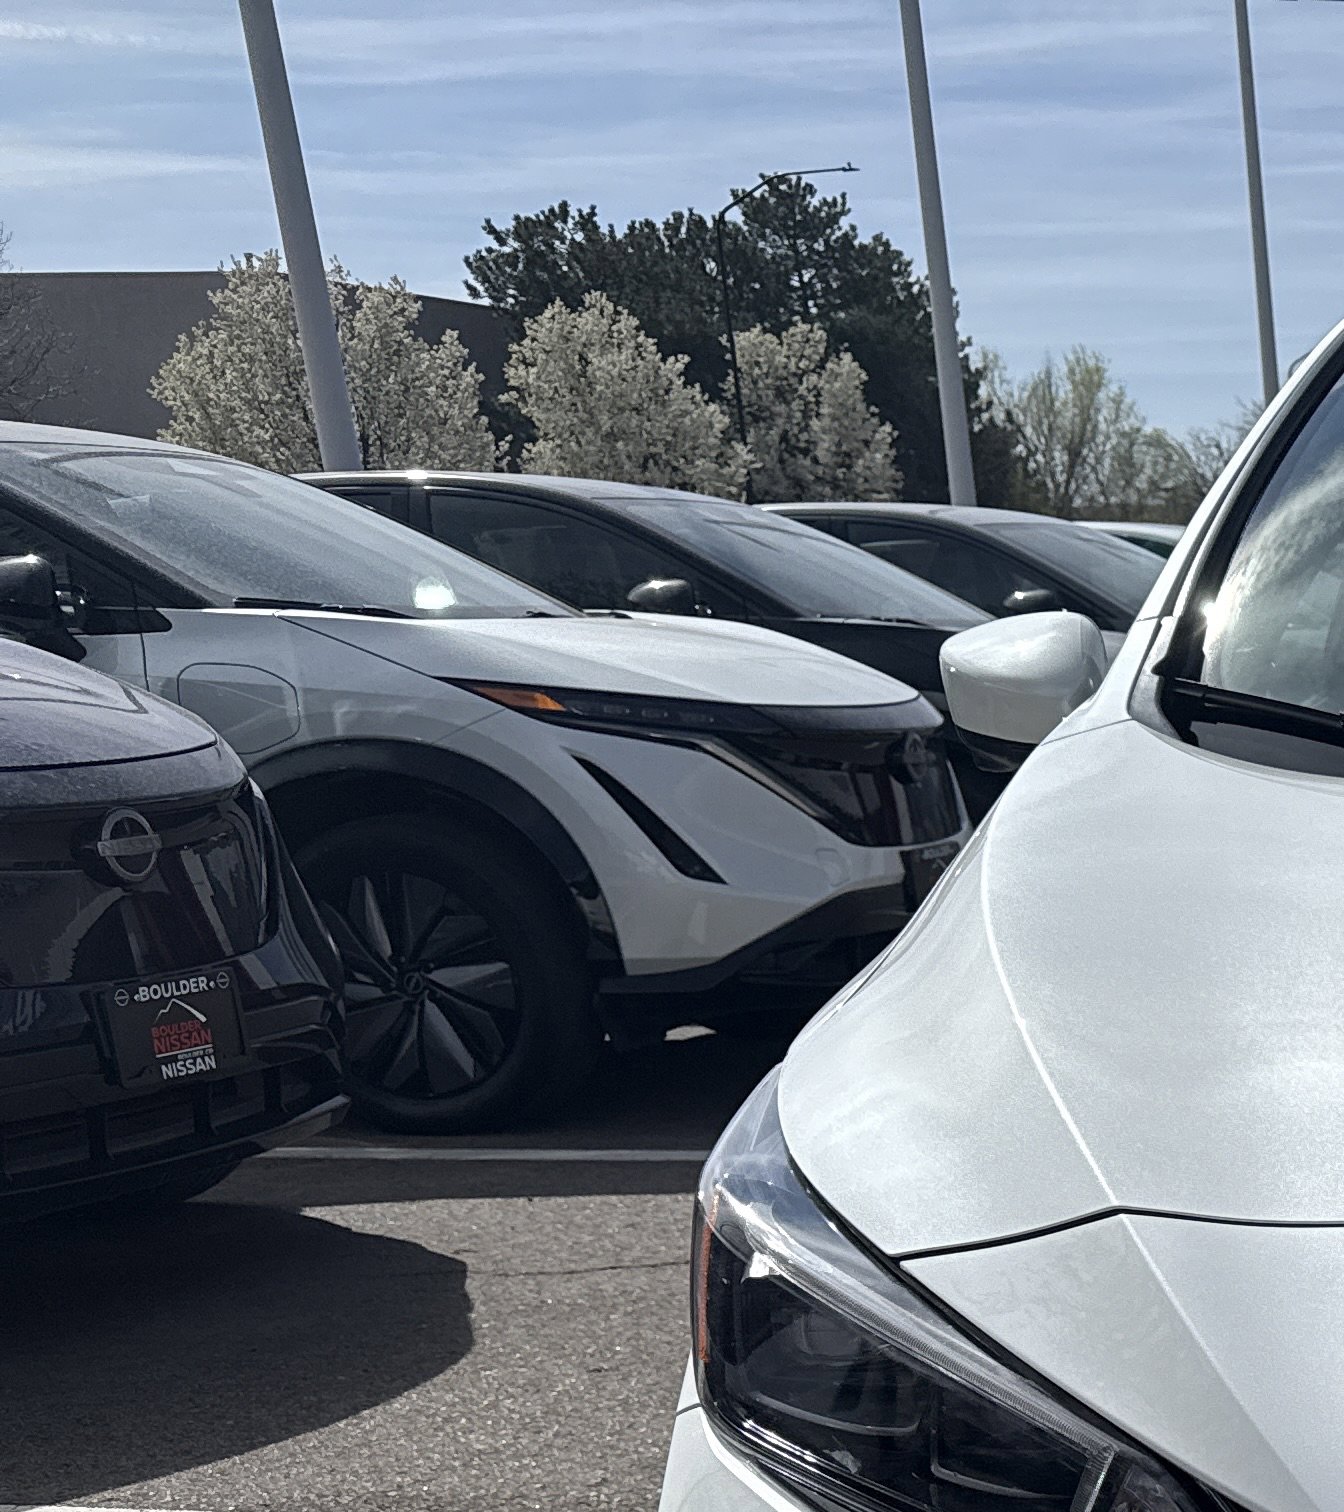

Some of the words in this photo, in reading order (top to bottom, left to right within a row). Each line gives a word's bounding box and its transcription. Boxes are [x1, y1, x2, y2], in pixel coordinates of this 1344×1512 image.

[138, 977, 209, 1002] BOULDER
[151, 1020, 202, 1037] BOULDER
[154, 1029, 212, 1053] NISSAN
[161, 1055, 217, 1080] NISSAN
